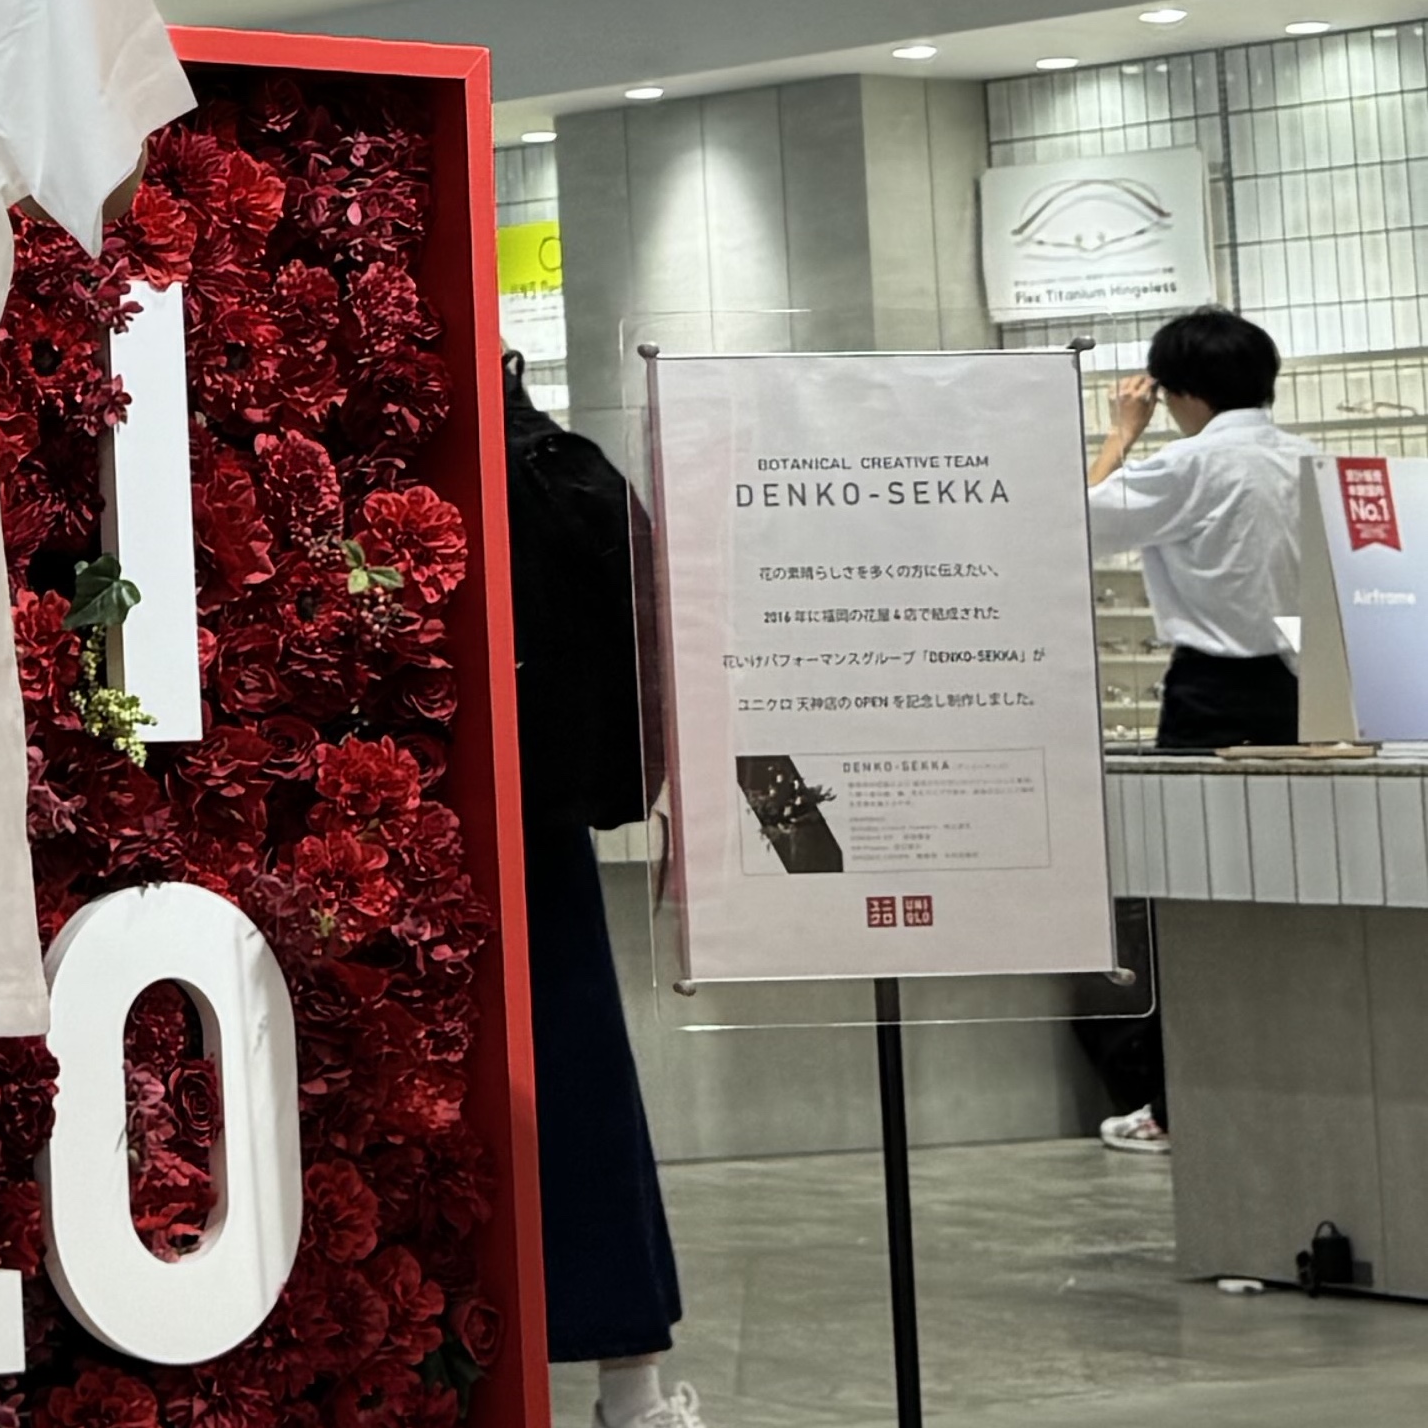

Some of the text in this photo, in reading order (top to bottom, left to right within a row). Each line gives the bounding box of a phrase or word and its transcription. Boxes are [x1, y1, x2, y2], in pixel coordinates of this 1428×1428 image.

[758, 455, 989, 471] BOTANICAL CREATIVE TEAM
[736, 479, 1010, 508] DENKO-SEKKA
[1353, 588, 1417, 606] Airframe
[843, 760, 950, 773] DENKO-SEKKA
